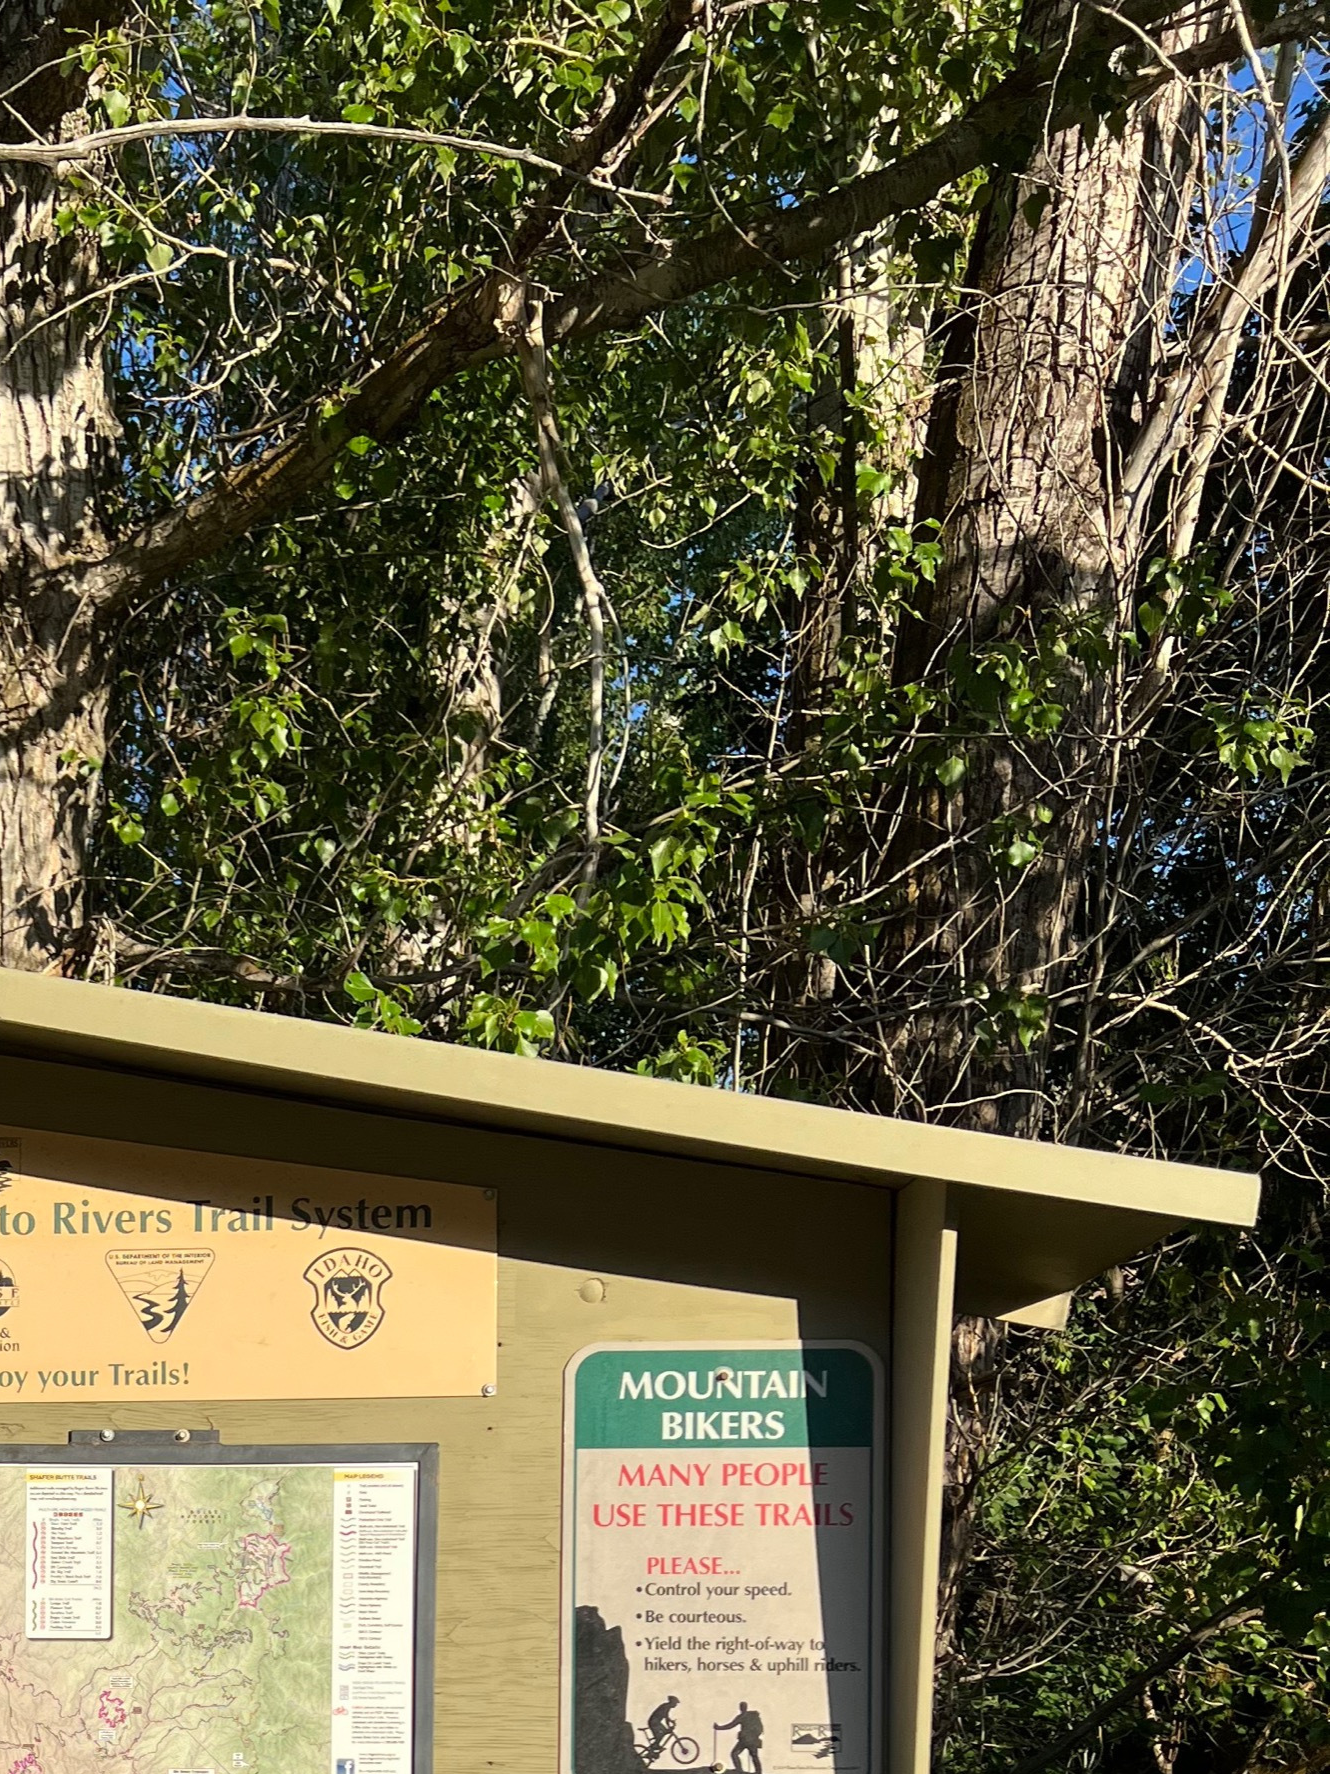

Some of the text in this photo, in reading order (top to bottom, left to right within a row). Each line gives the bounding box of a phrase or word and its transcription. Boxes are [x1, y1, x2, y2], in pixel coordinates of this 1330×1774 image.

[53, 1200, 172, 1235] Rivers
[190, 1196, 274, 1232] Trail
[290, 1197, 432, 1239] System
[313, 1254, 383, 1278] IDAHO
[0, 1327, 11, 1339] &
[318, 1313, 339, 1338] FISH
[352, 1313, 378, 1341] GAME
[37, 1367, 99, 1392] your
[108, 1361, 190, 1387] Trails!
[620, 1370, 828, 1400] MOUNTAIN
[661, 1411, 786, 1441] BIKERS
[618, 1462, 829, 1487] MANY PEOPLE
[593, 1502, 854, 1528] USE THESE TRAILS
[647, 1556, 741, 1576] PLEASE...
[645, 1581, 792, 1600] Control your speed.
[645, 1610, 747, 1624] Be courteous.
[644, 1637, 826, 1655] Yield the right-of-way to
[644, 1658, 862, 1676] hikers, horses & uphill riders.
